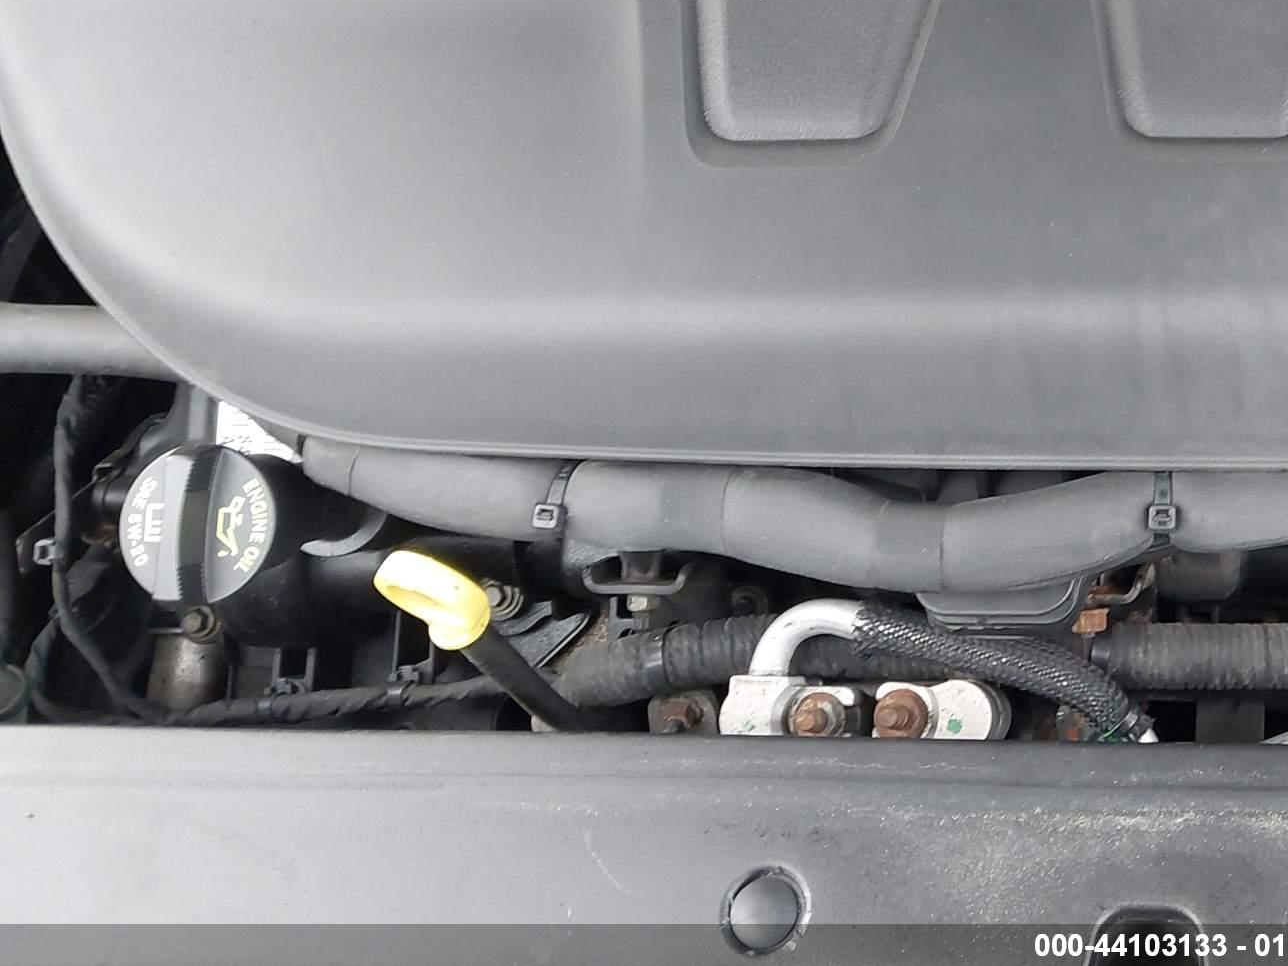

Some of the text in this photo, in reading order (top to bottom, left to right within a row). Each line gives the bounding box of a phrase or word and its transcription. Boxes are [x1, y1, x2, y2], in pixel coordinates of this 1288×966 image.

[132, 478, 158, 510] SAE
[242, 477, 268, 544] ENGINE
[233, 546, 260, 572] OIL
